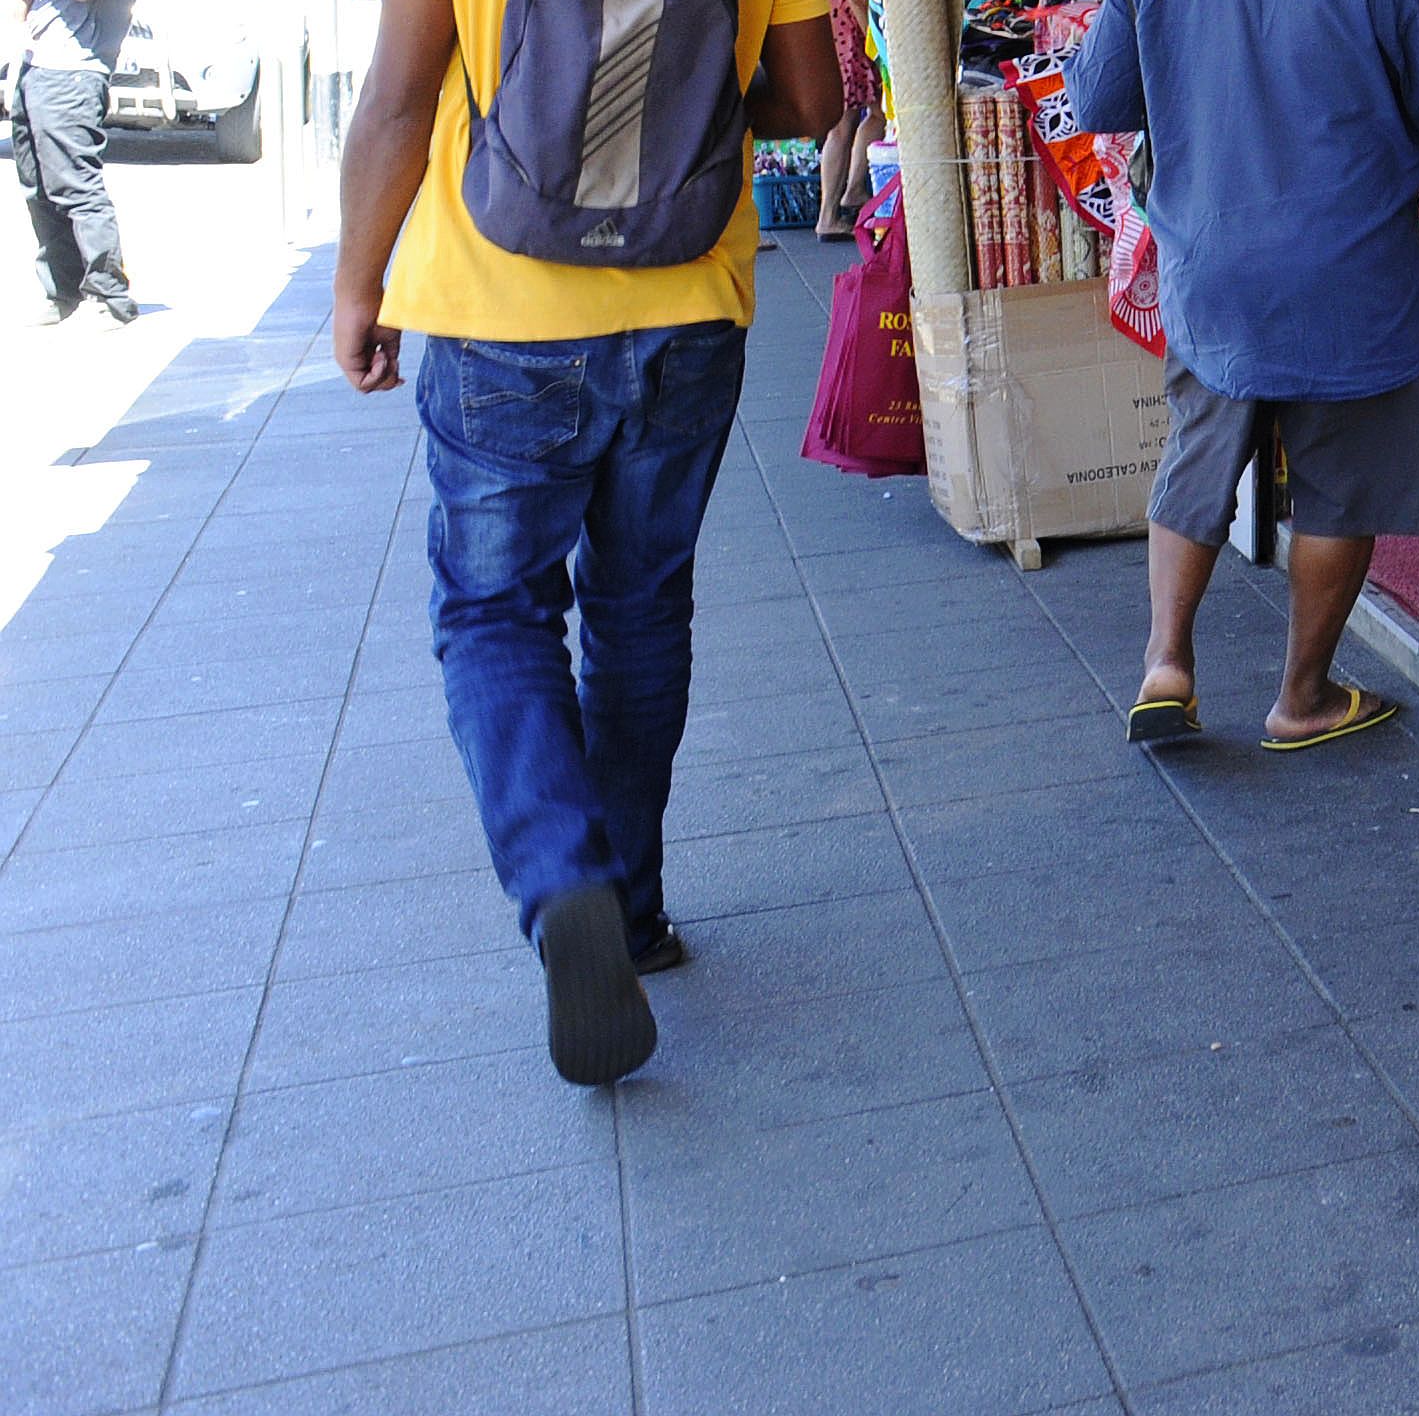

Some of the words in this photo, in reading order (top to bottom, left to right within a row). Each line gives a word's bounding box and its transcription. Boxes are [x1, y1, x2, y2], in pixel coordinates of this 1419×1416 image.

[890, 339, 915, 357] FA
[1066, 462, 1137, 484] CALEDONIA
[1140, 459, 1162, 473] EW
